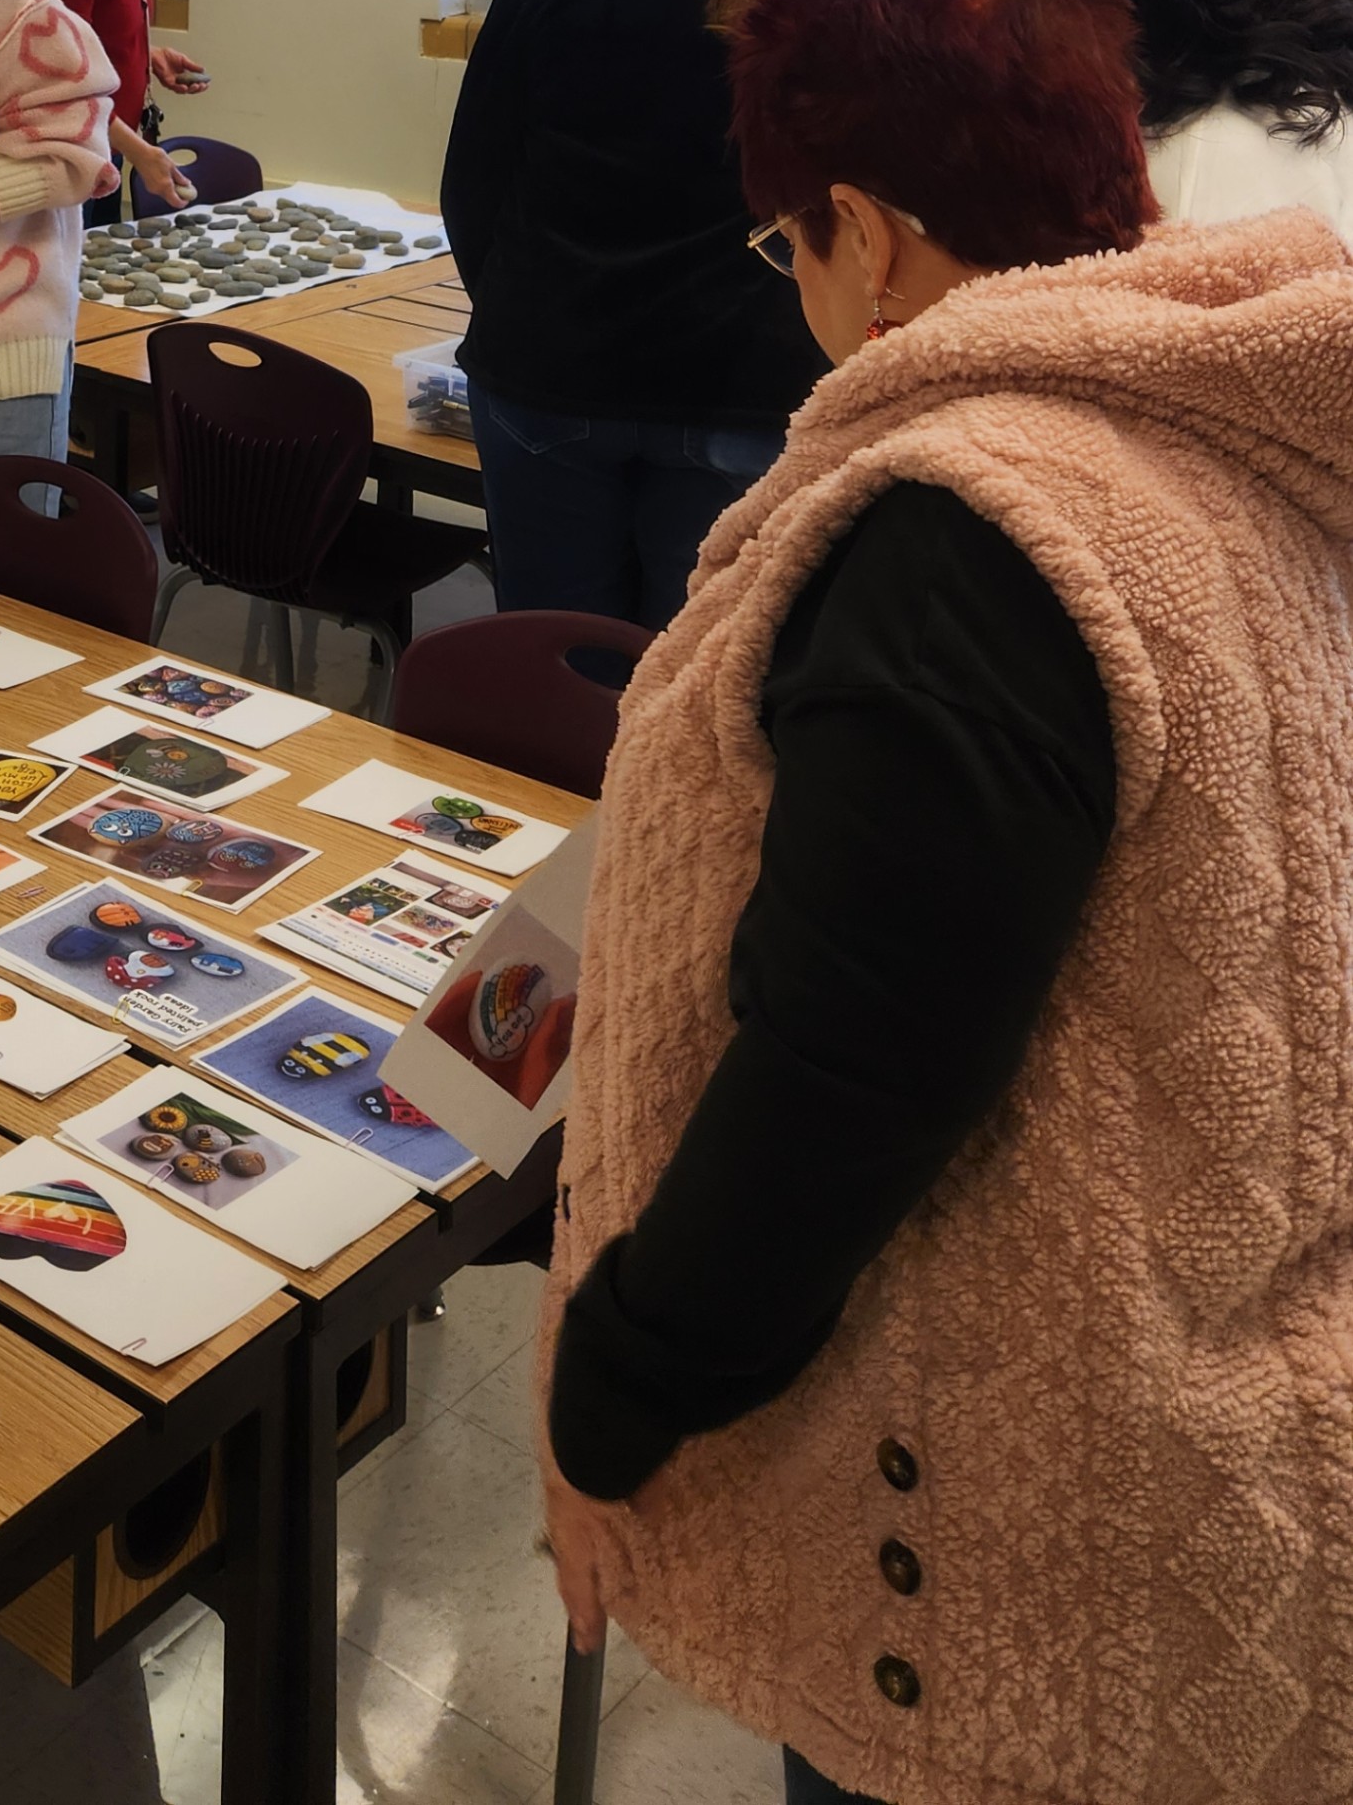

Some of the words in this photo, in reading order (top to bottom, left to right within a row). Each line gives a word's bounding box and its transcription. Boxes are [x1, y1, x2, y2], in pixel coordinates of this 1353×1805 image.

[123, 996, 161, 1020] Garden
[134, 991, 160, 1006] rock
[157, 1004, 204, 1027] painted
[161, 1017, 192, 1033] Fairy
